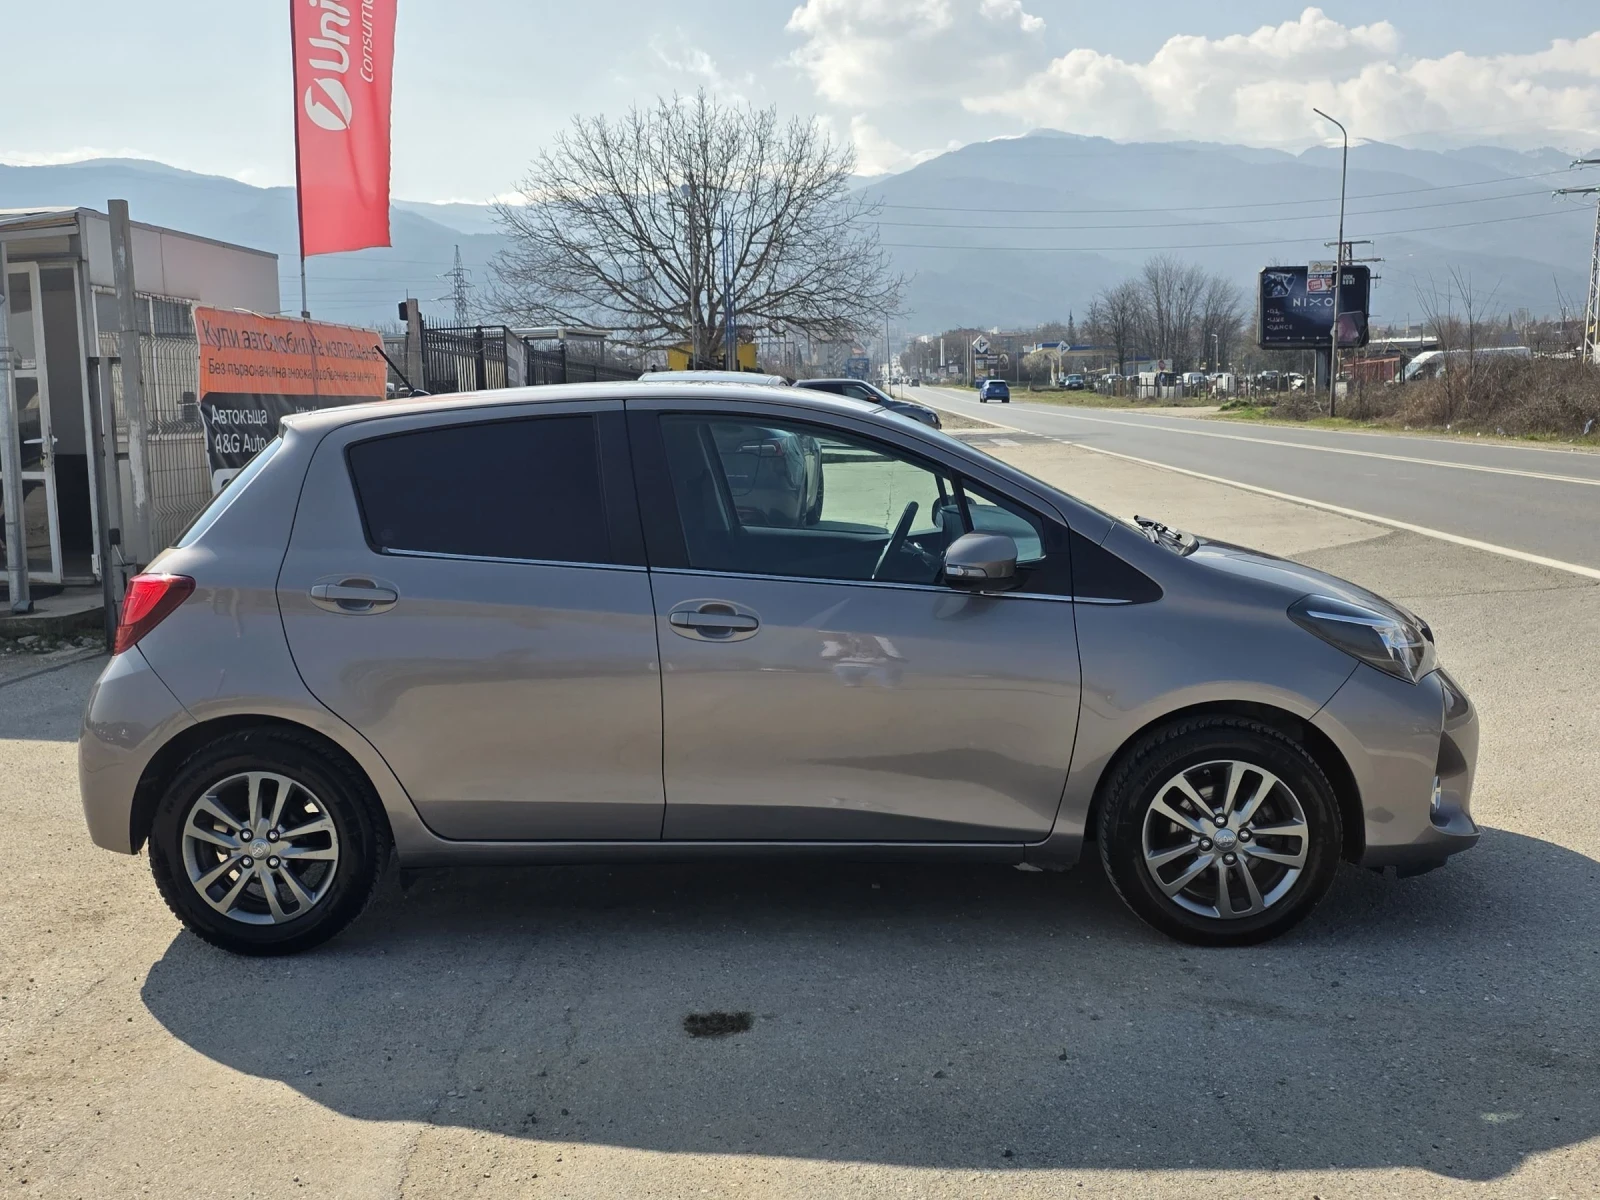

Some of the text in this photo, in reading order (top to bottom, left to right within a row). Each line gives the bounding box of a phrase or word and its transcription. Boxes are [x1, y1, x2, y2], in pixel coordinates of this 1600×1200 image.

[1293, 298, 1334, 307] NIXO
[202, 319, 241, 351] Купи
[242, 330, 309, 355] автомобил
[208, 357, 226, 375] Без
[227, 362, 287, 380] първоначална
[211, 404, 268, 427] Автокъща
[215, 433, 267, 453] A&G Auto
